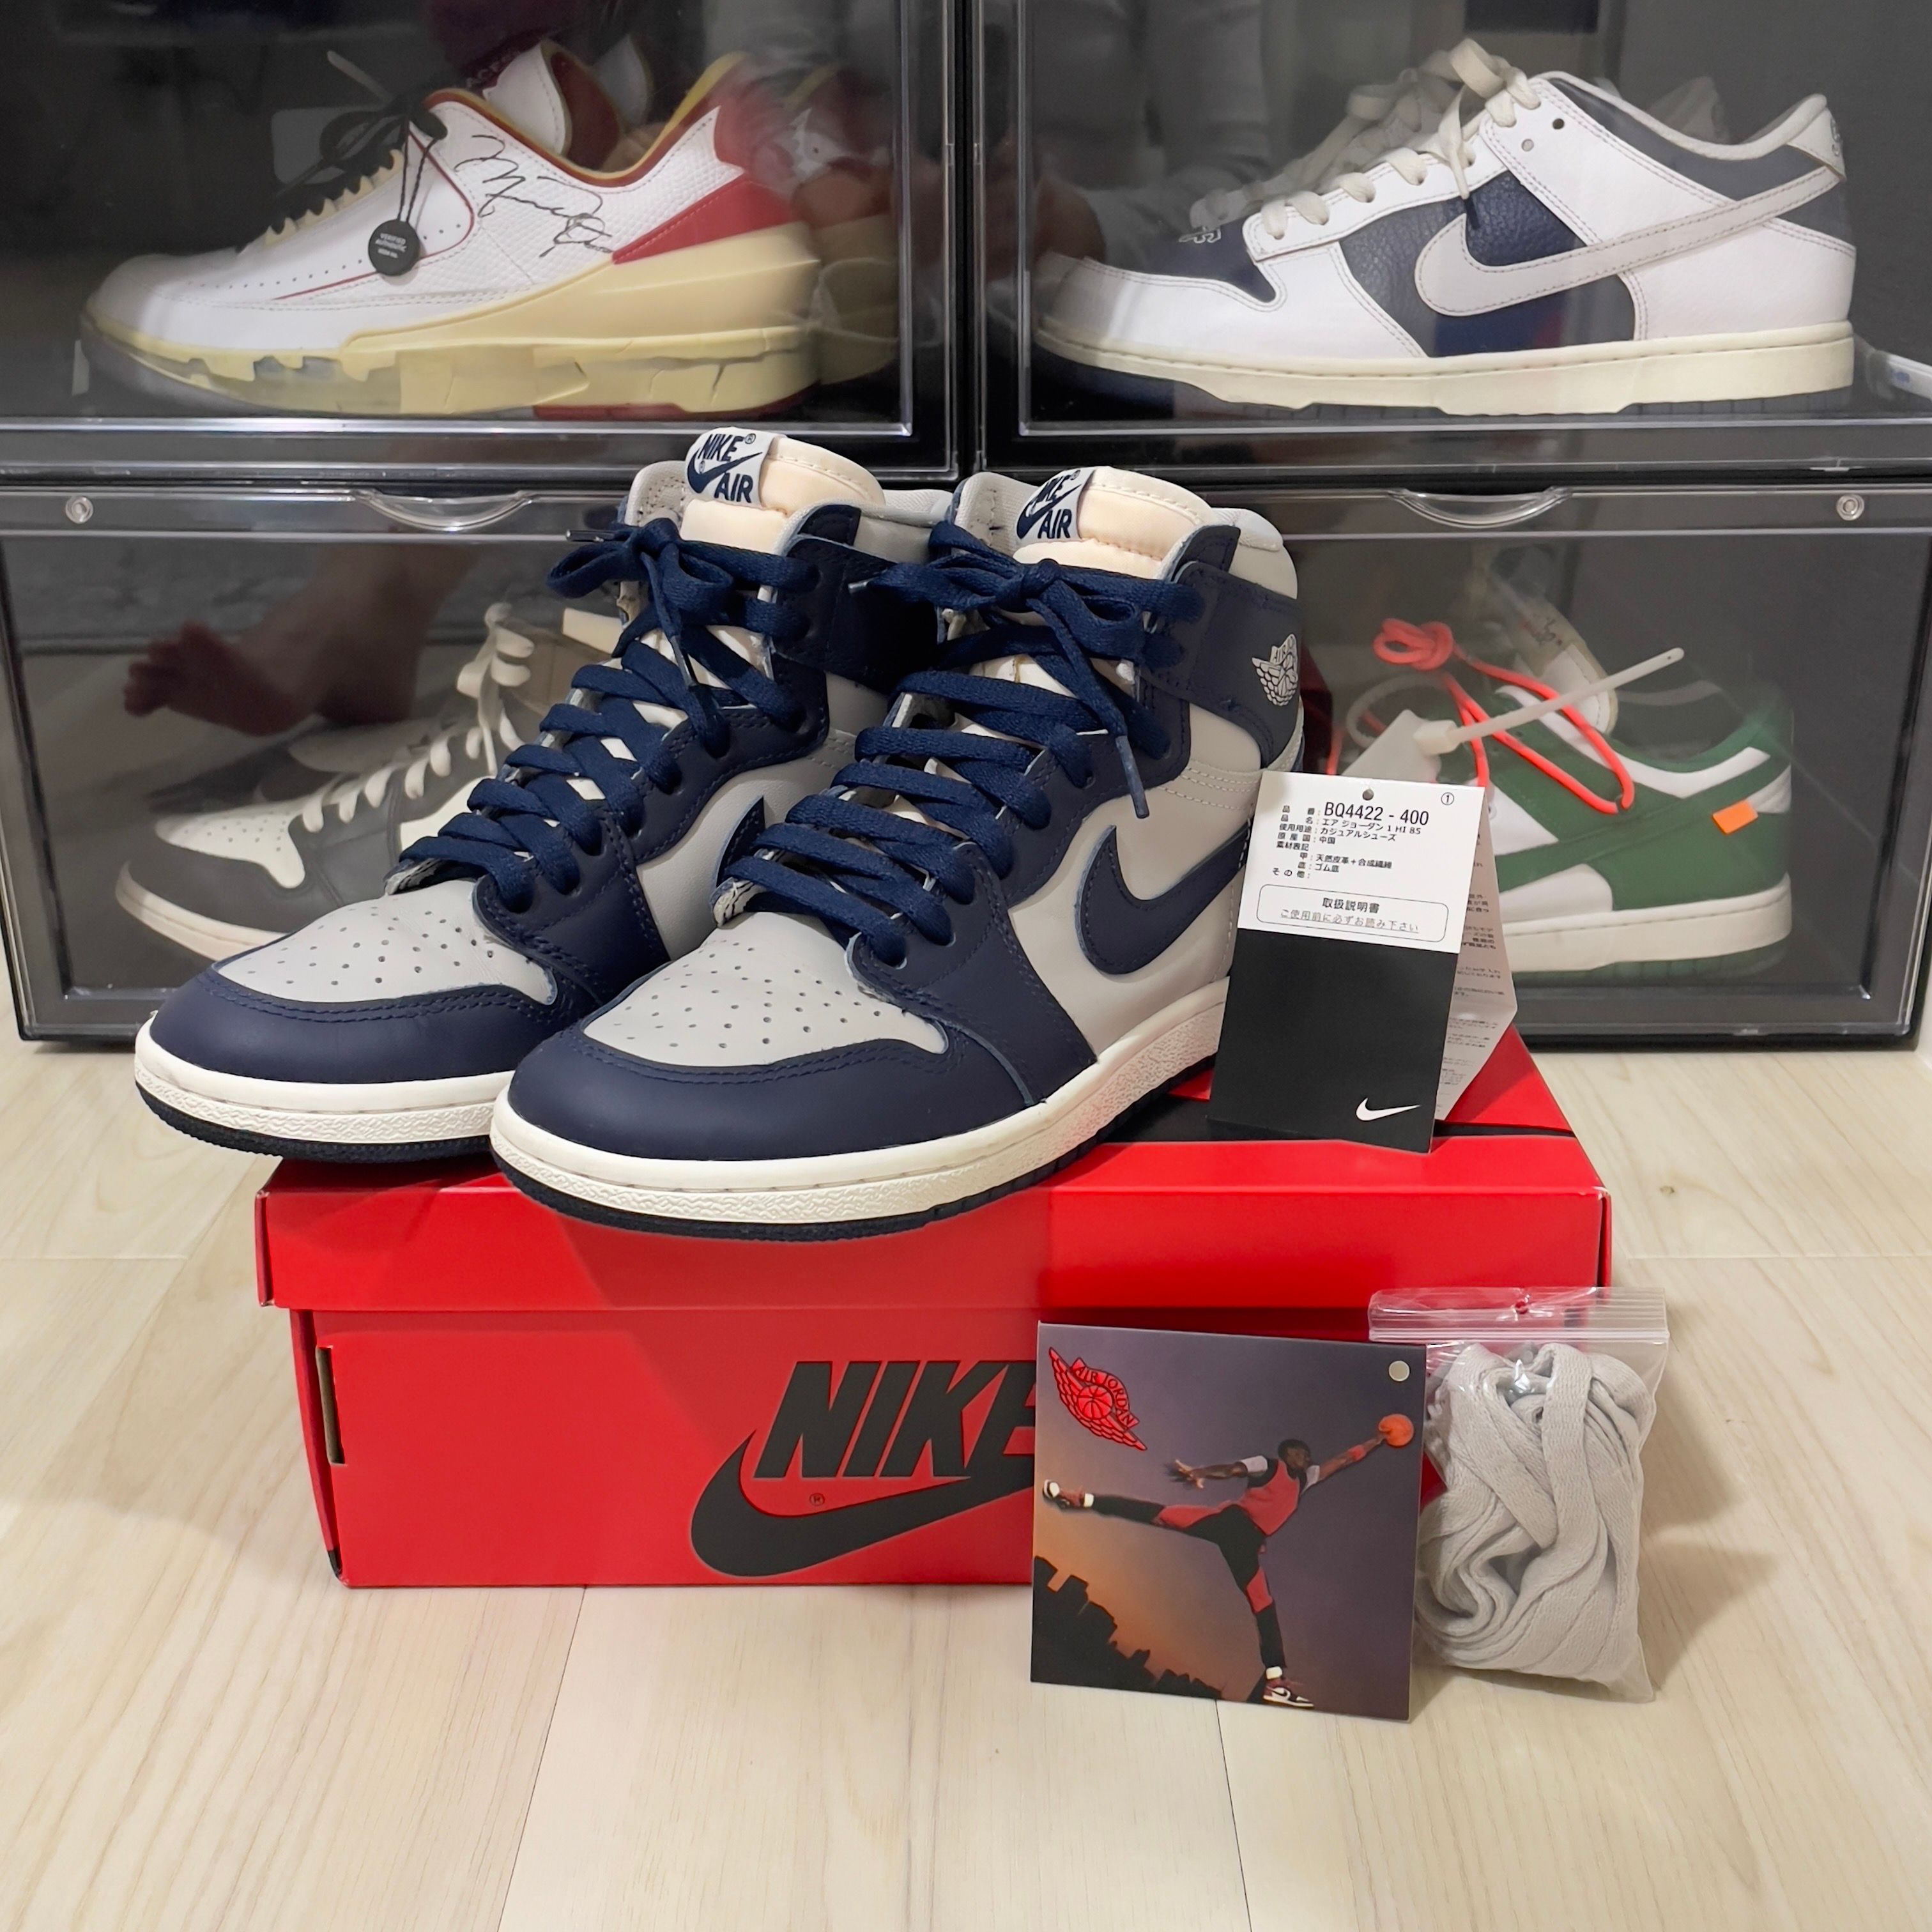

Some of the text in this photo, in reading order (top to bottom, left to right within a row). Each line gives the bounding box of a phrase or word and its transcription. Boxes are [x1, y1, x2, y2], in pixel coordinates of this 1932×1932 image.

[698, 434, 744, 461] NIKE
[714, 473, 753, 503] AIR
[1038, 509, 1072, 539] AIR
[1324, 802, 1383, 821] BQ4422
[1400, 809, 1429, 825] 400
[1342, 820, 1383, 831] ジョーダン
[1322, 898, 1380, 914] 取扱説明書
[1072, 1366, 1135, 1427] AIR JORDAN
[753, 1361, 1037, 1478] NIKE
